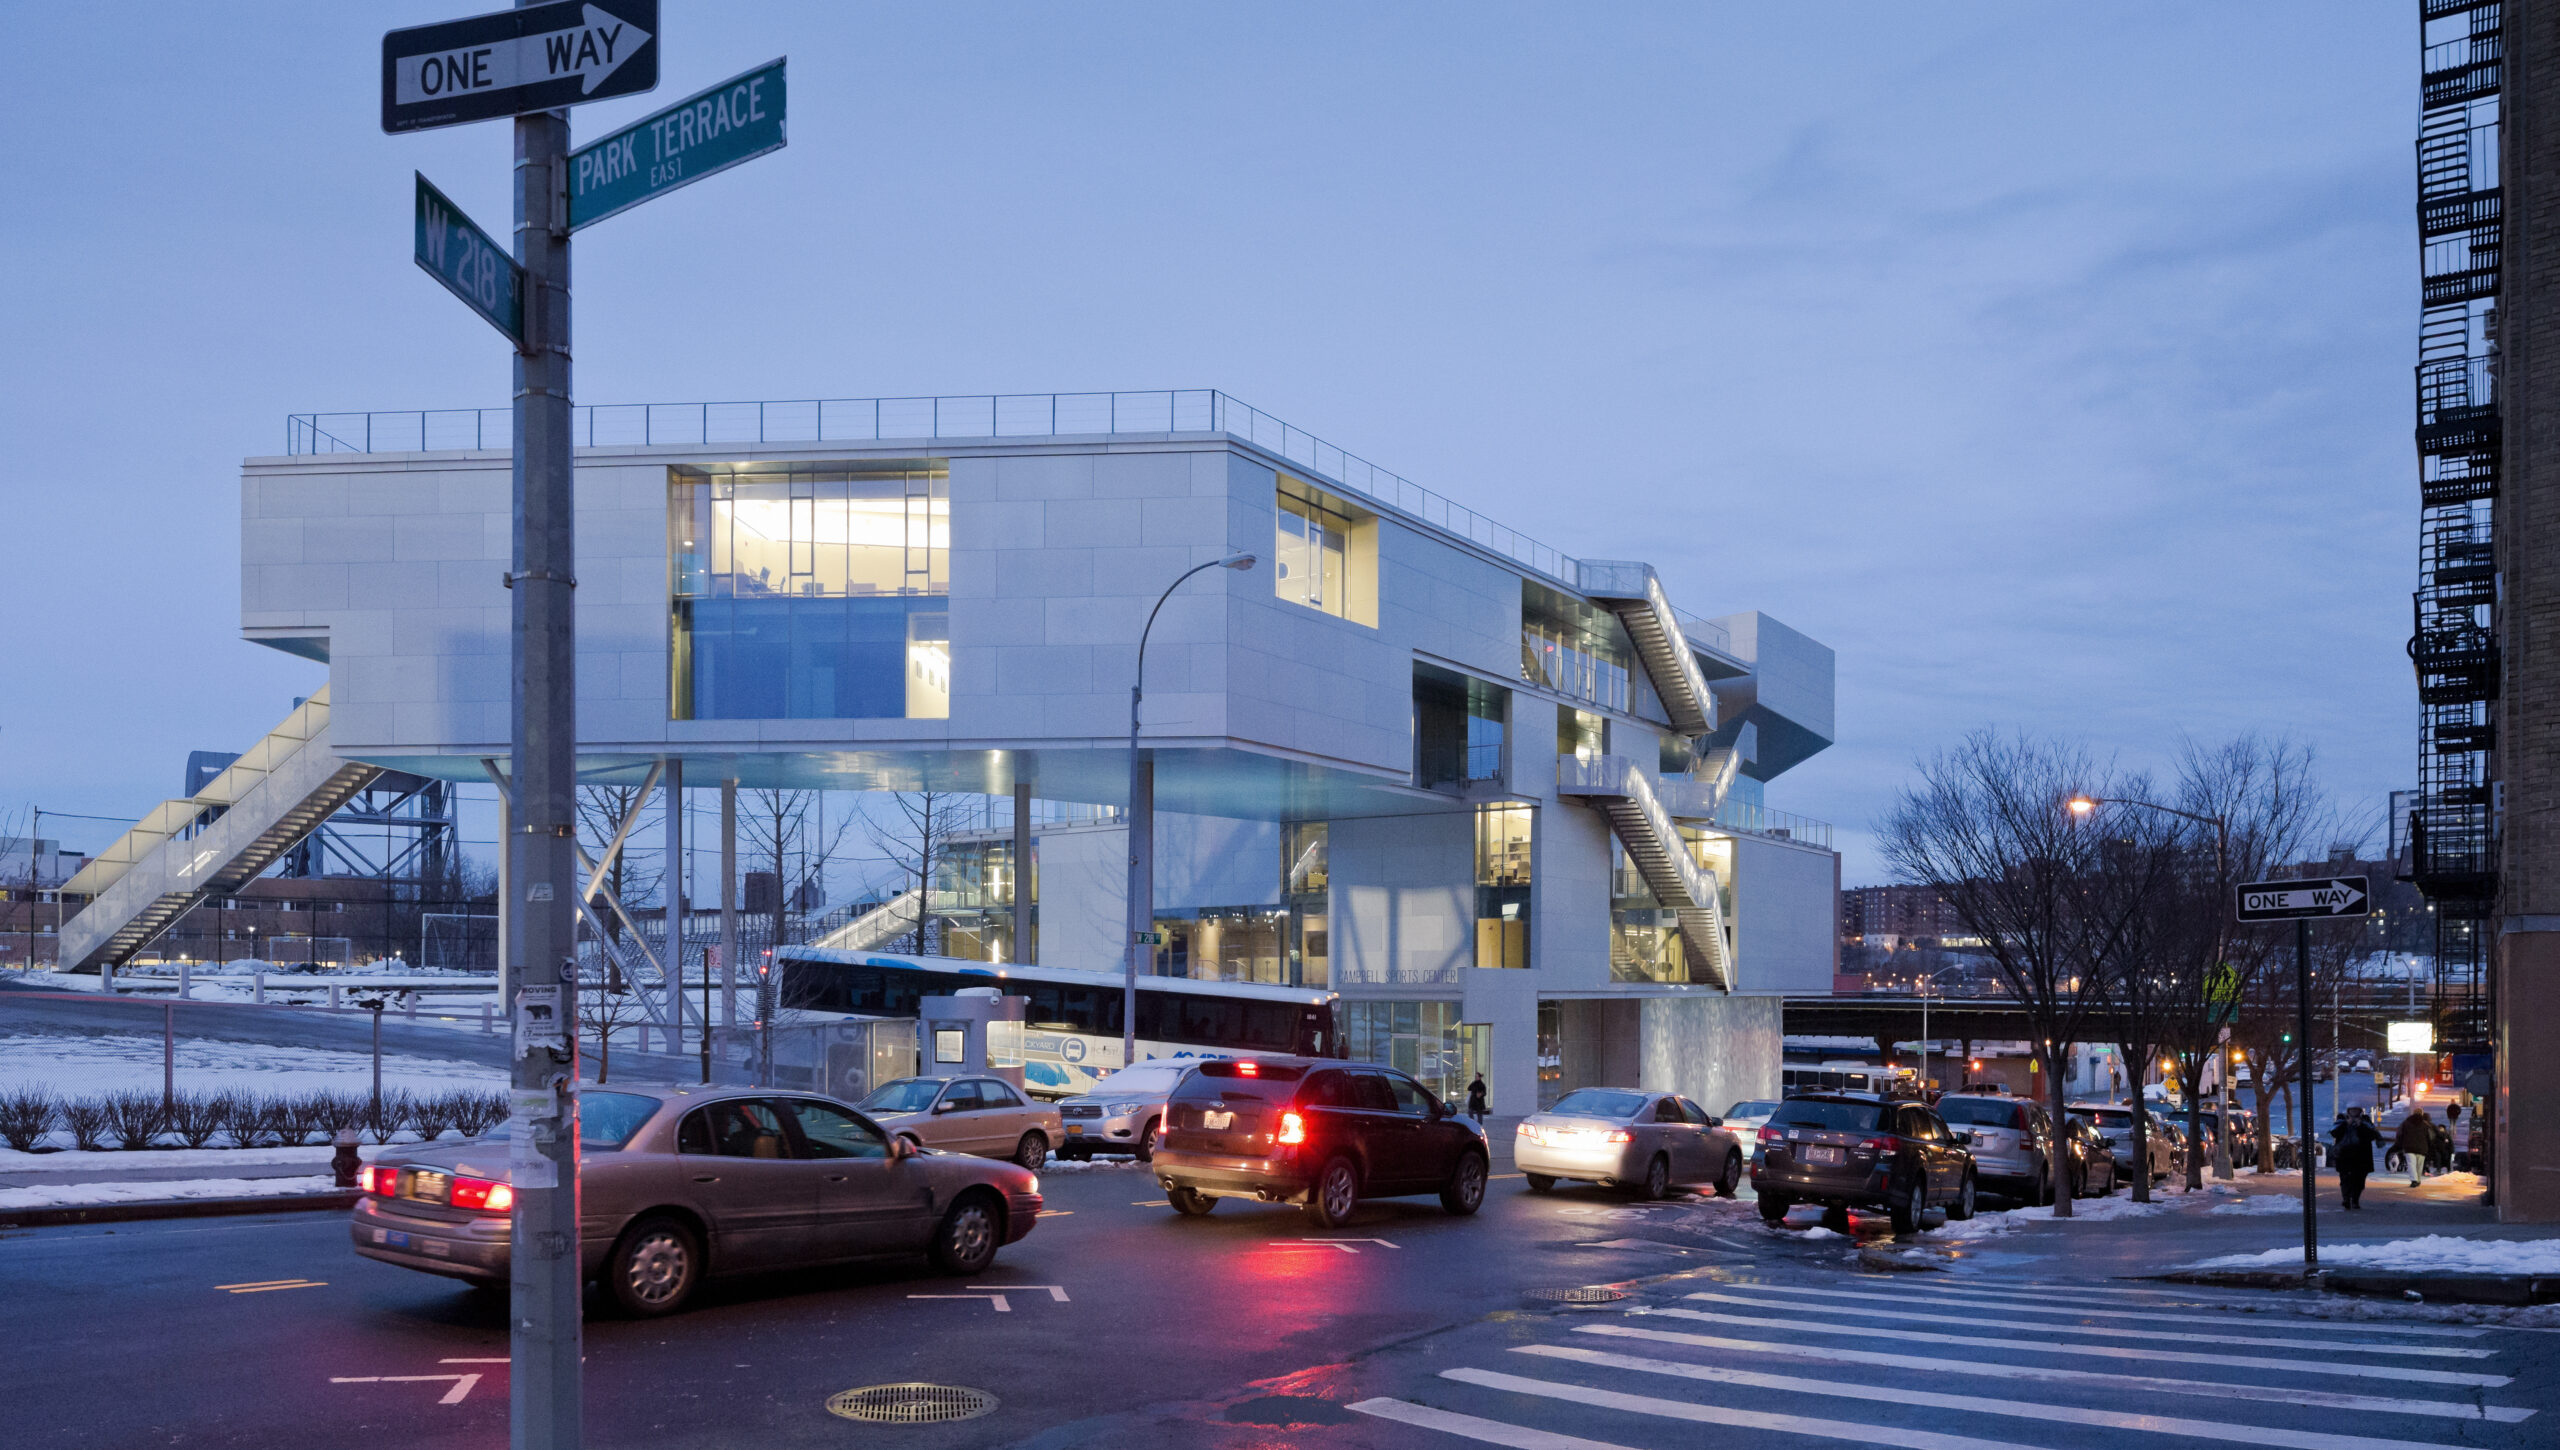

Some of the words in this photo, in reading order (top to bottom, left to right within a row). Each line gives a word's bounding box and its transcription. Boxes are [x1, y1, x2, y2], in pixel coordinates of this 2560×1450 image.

[421, 49, 493, 96] ONE
[546, 22, 623, 75] WAY
[578, 132, 638, 196] PARK
[650, 75, 766, 163] TERRACE
[650, 156, 683, 188] EAST
[423, 191, 449, 271] W
[456, 225, 497, 311] 218
[507, 266, 521, 305] ST
[2248, 893, 2290, 909] ONE
[2312, 888, 2353, 906] WAY
[1136, 933, 1143, 943] W
[1144, 933, 1155, 944] 218
[1338, 969, 1378, 984] CAMPBELL
[1385, 969, 1419, 984] SPORTS
[1423, 969, 1458, 984] CENTER
